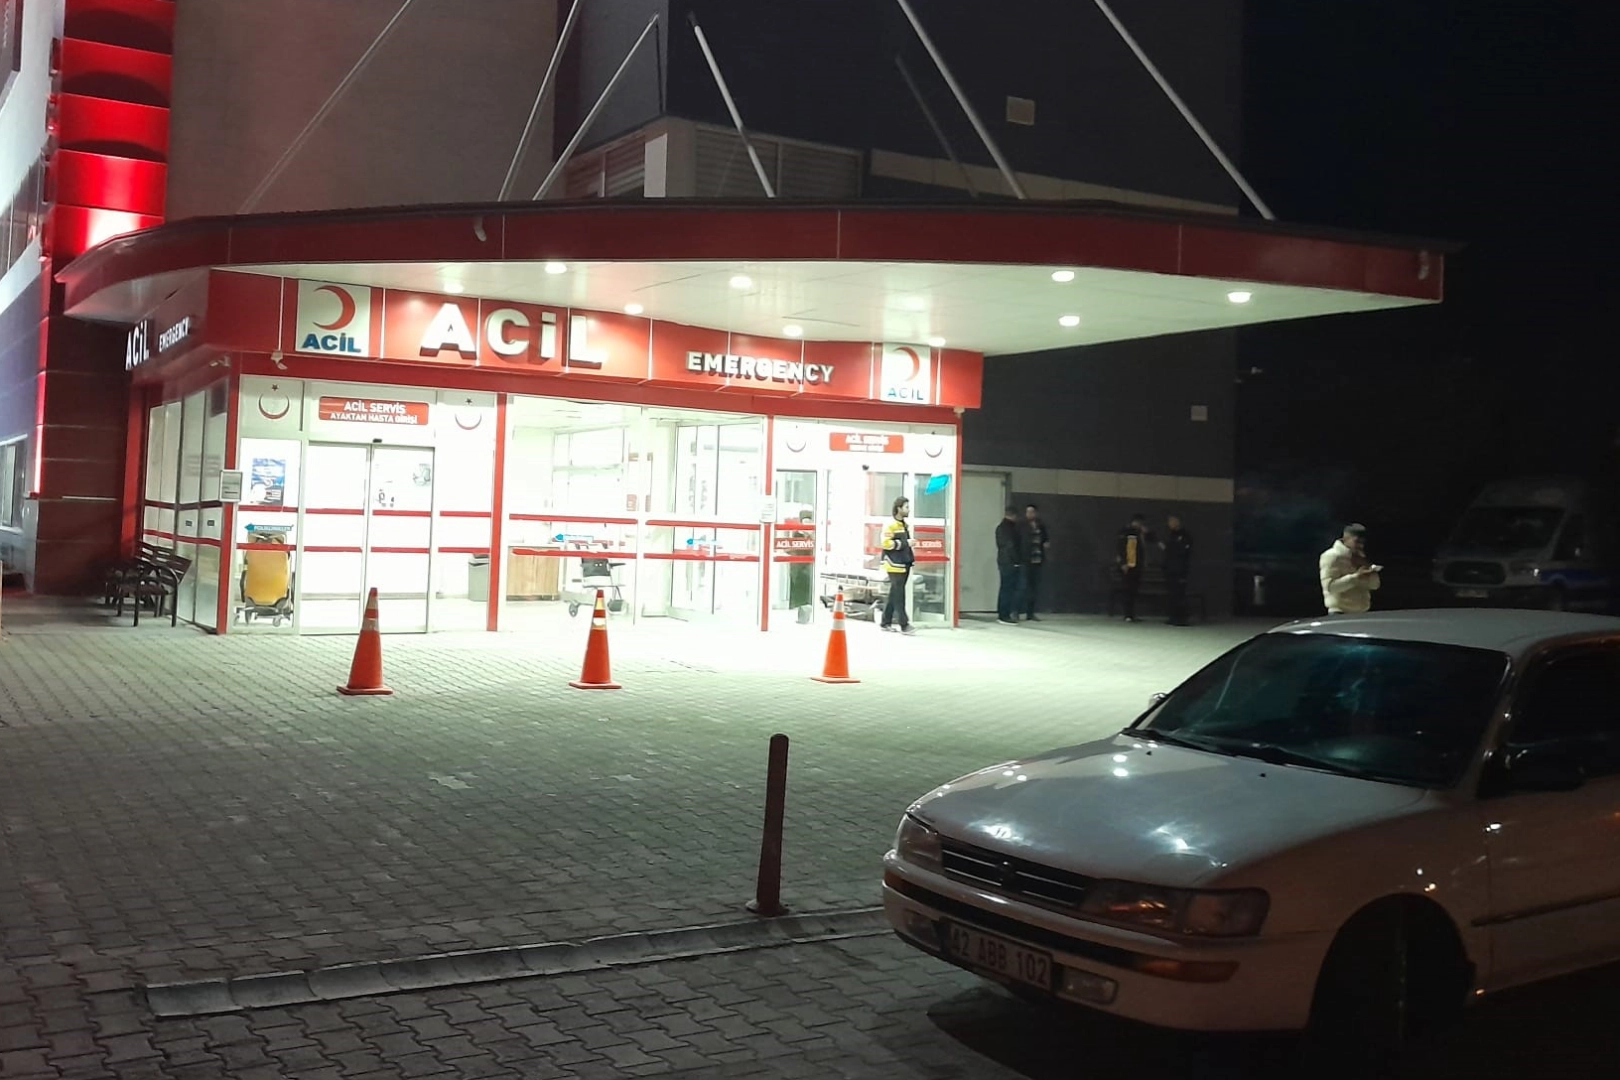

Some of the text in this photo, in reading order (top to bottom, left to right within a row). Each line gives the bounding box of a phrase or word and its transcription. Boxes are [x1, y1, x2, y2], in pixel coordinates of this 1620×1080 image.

[158, 316, 189, 352] EMERGENCY
[687, 351, 835, 383] EMERGENCY
[978, 938, 1008, 970] ABB
[1017, 951, 1048, 985] 102
